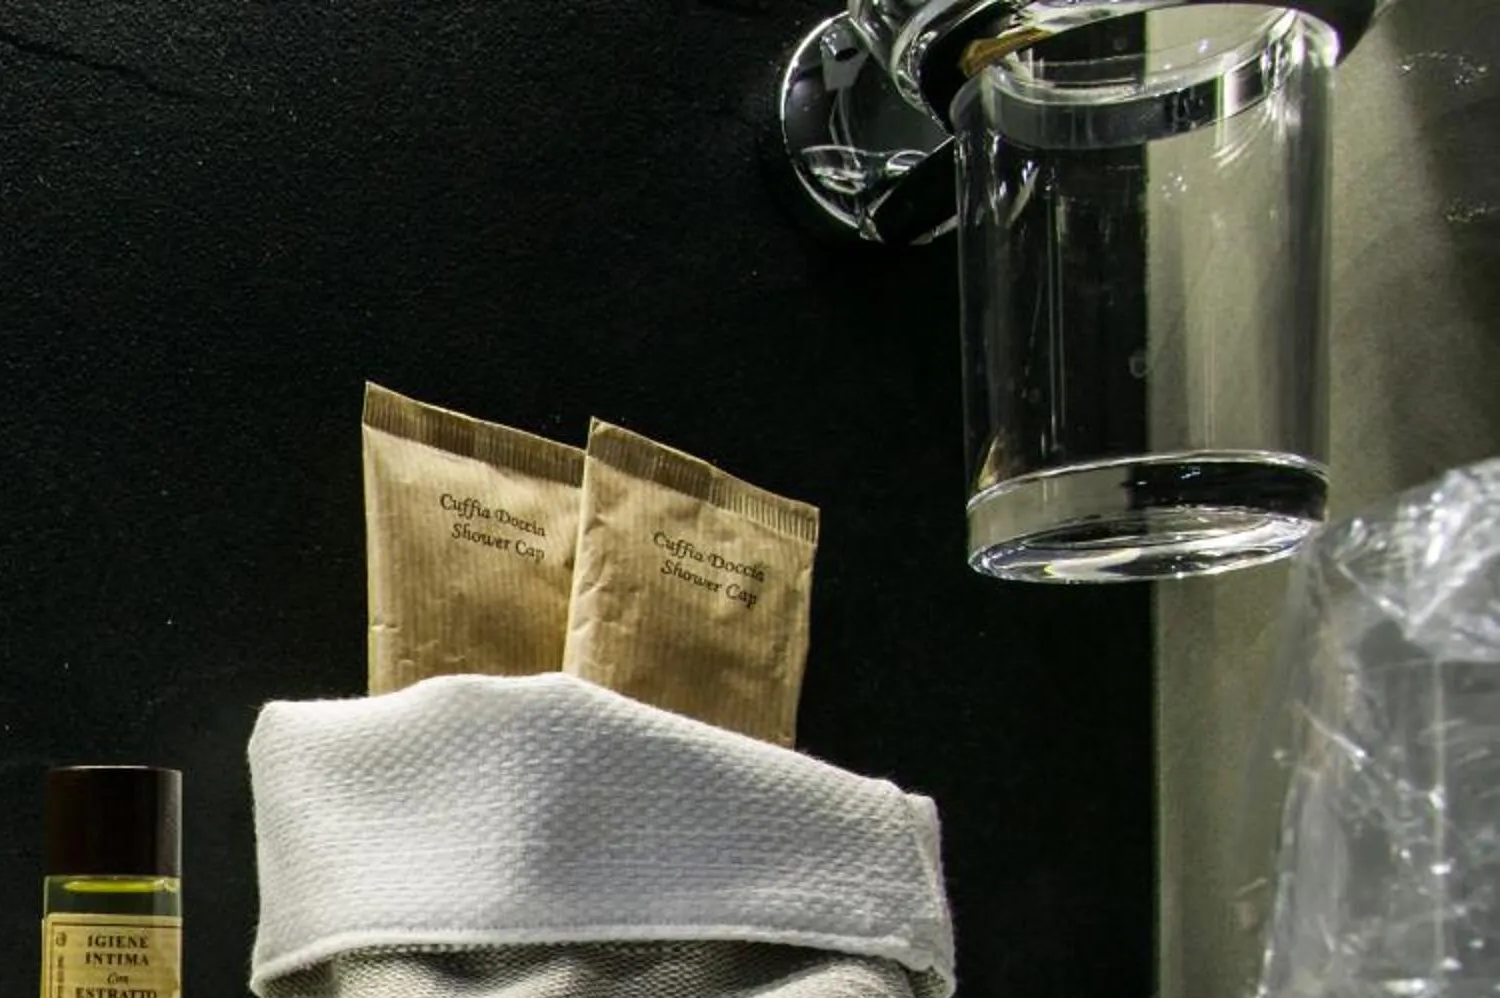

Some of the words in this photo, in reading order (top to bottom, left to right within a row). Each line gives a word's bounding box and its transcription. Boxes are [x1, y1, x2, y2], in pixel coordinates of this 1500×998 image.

[439, 493, 491, 520] Cuffia
[494, 508, 546, 538] Doccia
[451, 522, 511, 551] Shower
[515, 538, 545, 565] Cap
[653, 530, 704, 562] Cuffia
[707, 552, 765, 583] Doccia
[660, 559, 722, 593] Shower
[725, 583, 757, 610] Cap
[84, 951, 150, 967] INTIMA
[86, 934, 150, 949] IGIENE
